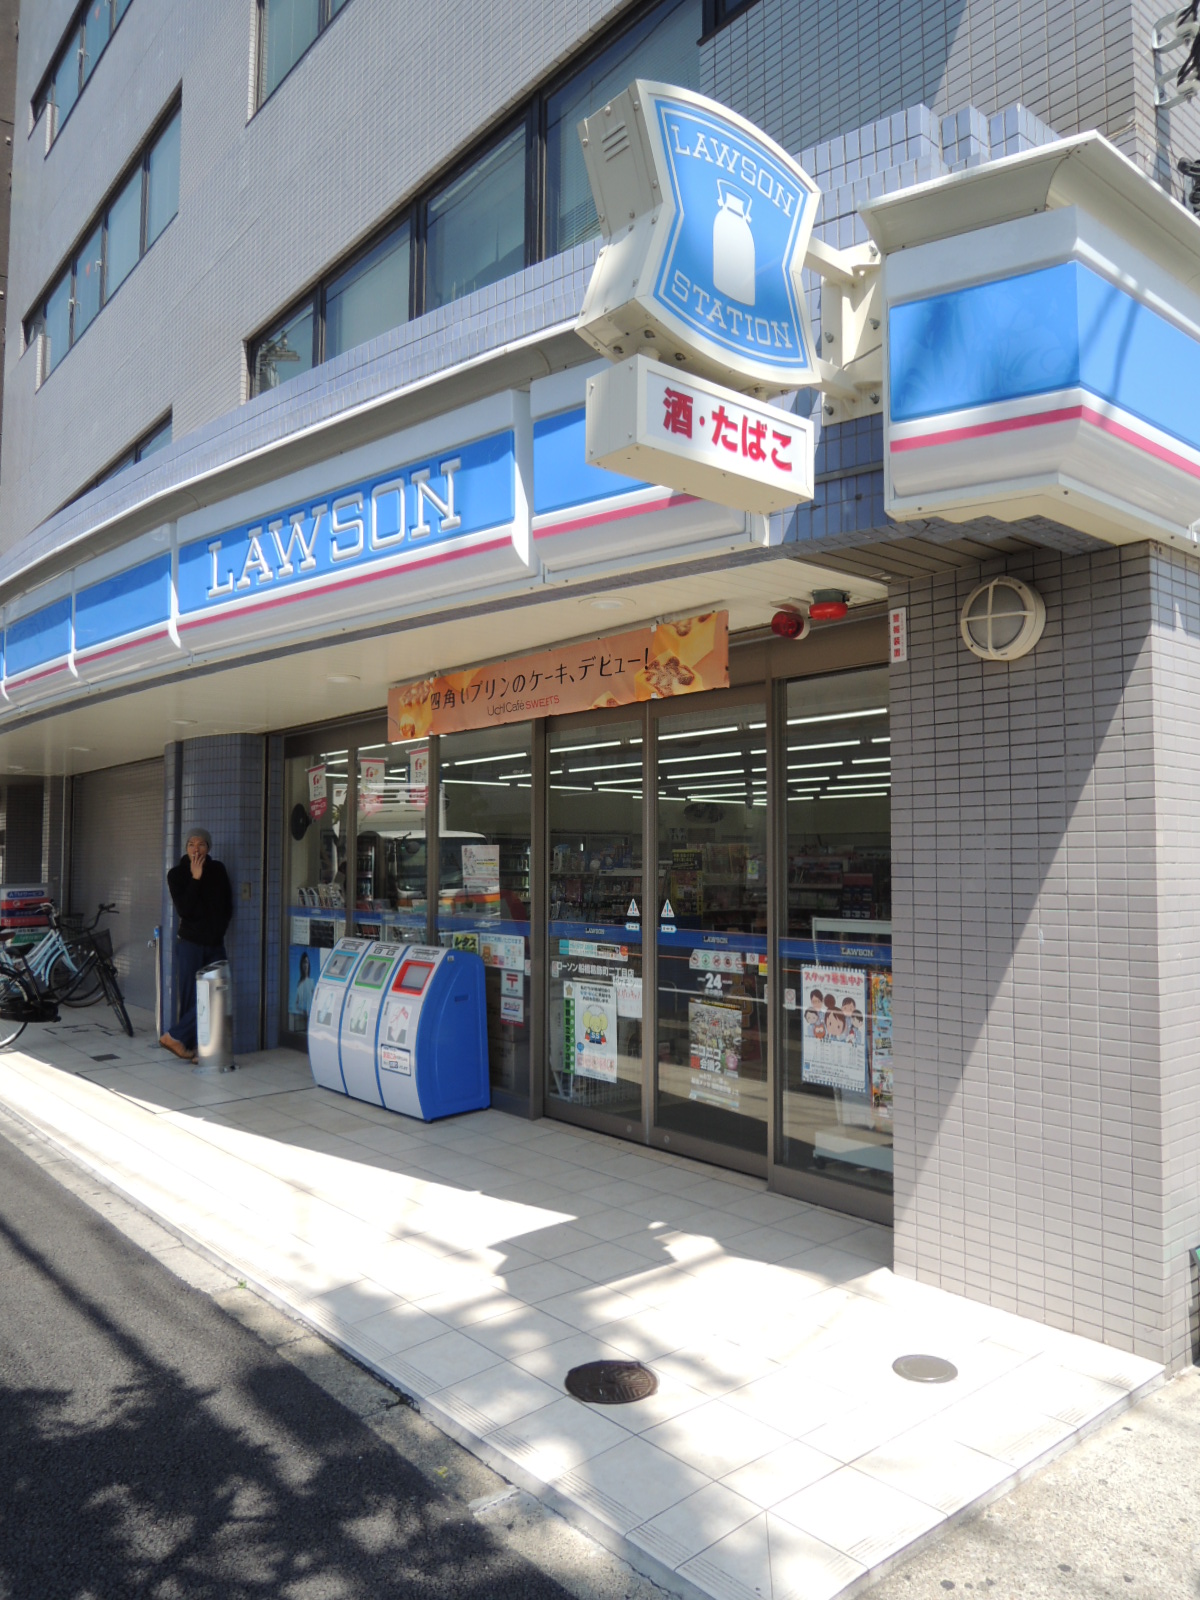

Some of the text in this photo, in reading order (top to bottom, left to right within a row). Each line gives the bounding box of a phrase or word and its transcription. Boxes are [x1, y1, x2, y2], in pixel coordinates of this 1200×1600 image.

[671, 125, 796, 217] LAWSON
[671, 270, 793, 349] STATION
[662, 386, 793, 472] 酒・たばこ
[207, 457, 462, 599] LAWSON
[525, 695, 560, 710] SWEETS
[454, 937, 477, 946] レタス
[840, 947, 875, 957] LAWSON
[705, 972, 722, 989] 24
